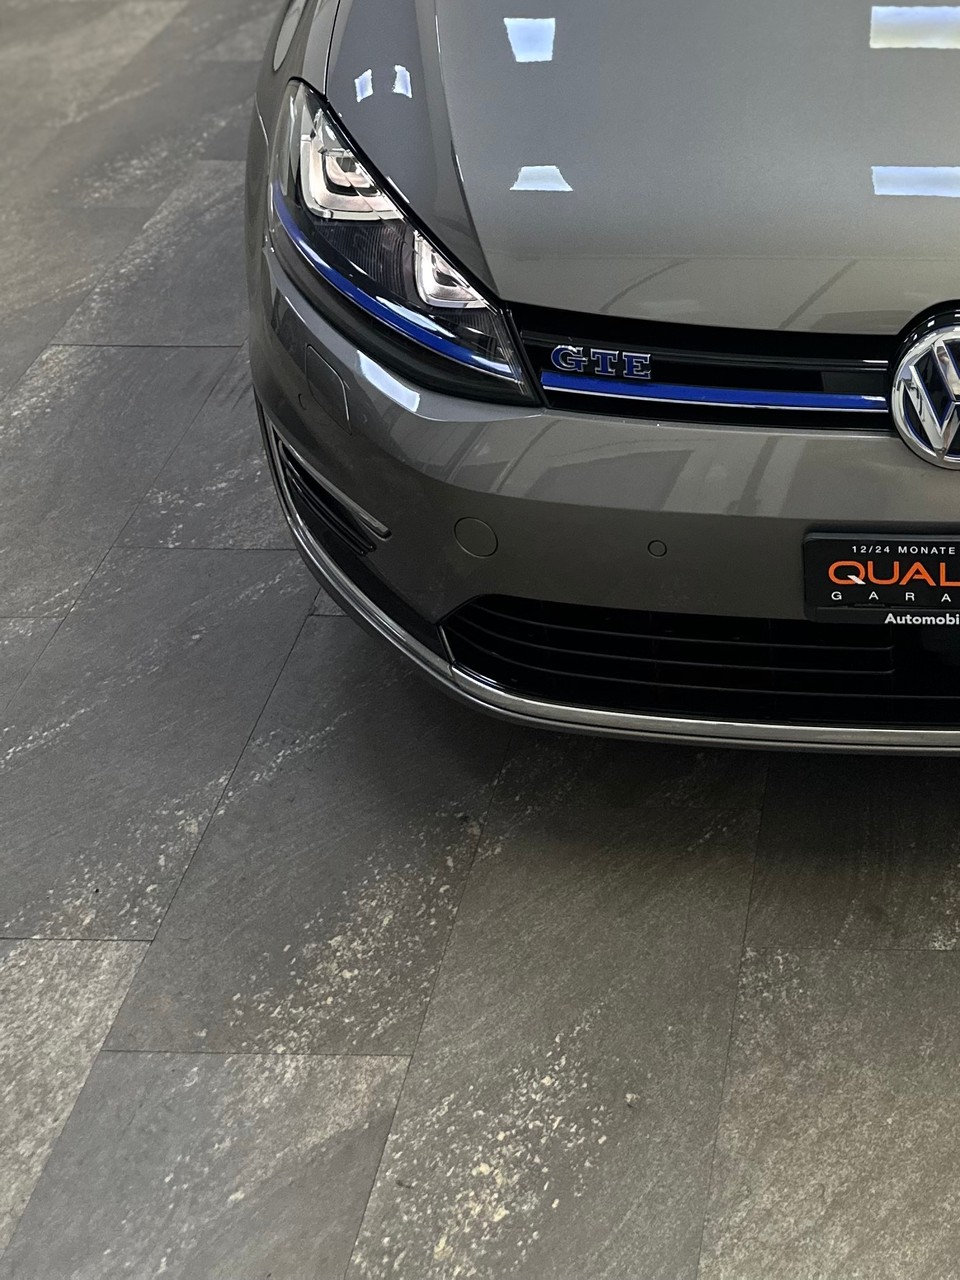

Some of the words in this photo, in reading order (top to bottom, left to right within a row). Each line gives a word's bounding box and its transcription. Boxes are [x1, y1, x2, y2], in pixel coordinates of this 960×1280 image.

[551, 345, 651, 379] GTE
[851, 545, 891, 554] 12/24
[898, 546, 956, 555] MONATE
